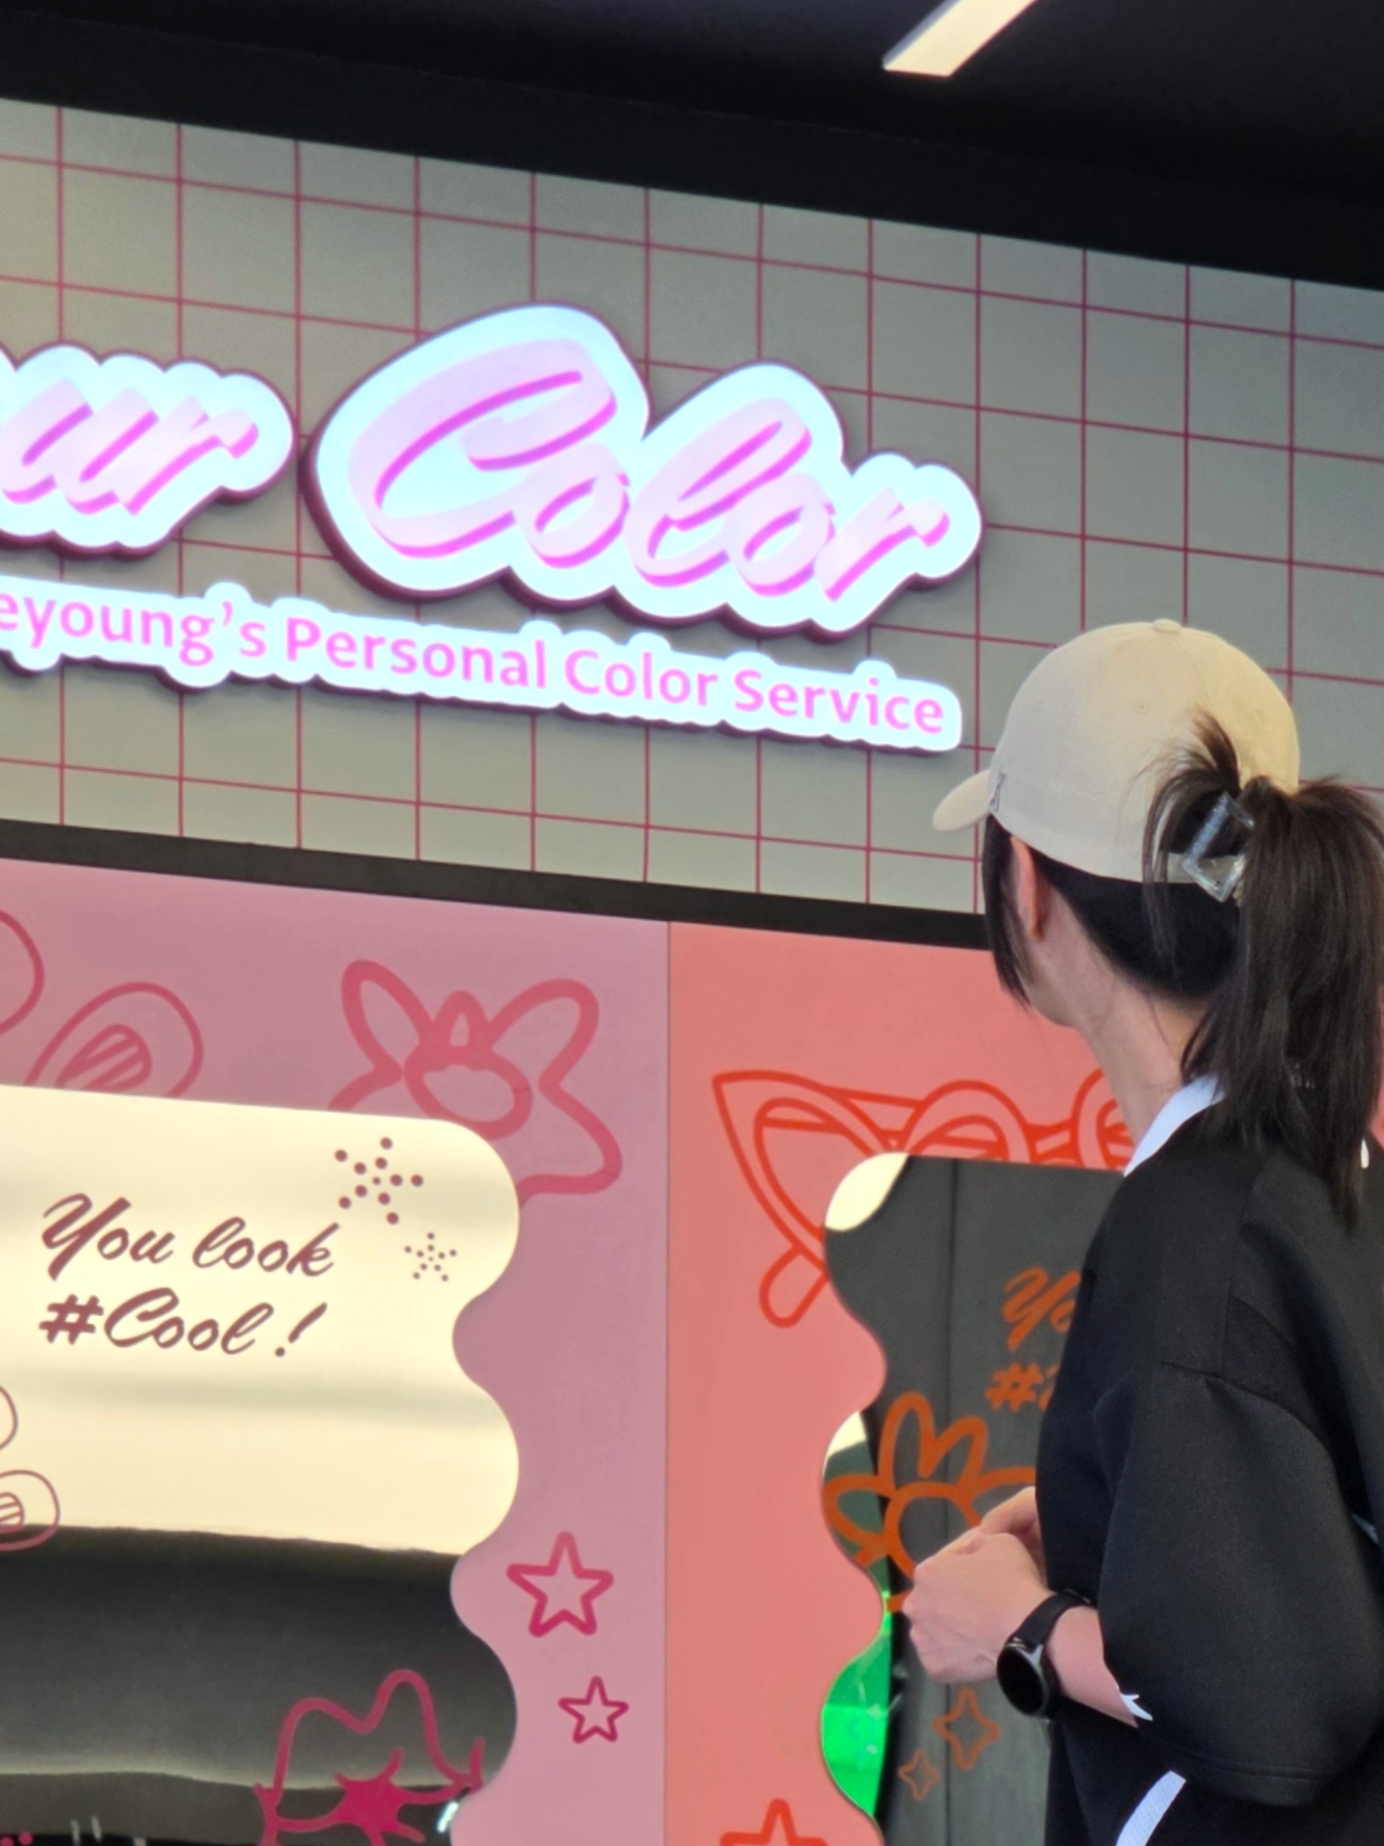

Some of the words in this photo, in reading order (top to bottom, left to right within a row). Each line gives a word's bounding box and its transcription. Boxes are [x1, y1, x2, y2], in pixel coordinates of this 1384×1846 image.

[348, 338, 950, 602] Color
[285, 617, 547, 689] Personal
[566, 648, 719, 708] Color
[734, 667, 944, 733] Service
[42, 1193, 175, 1280] You
[192, 1216, 340, 1277] look
[39, 1286, 328, 1357] #Cool!
